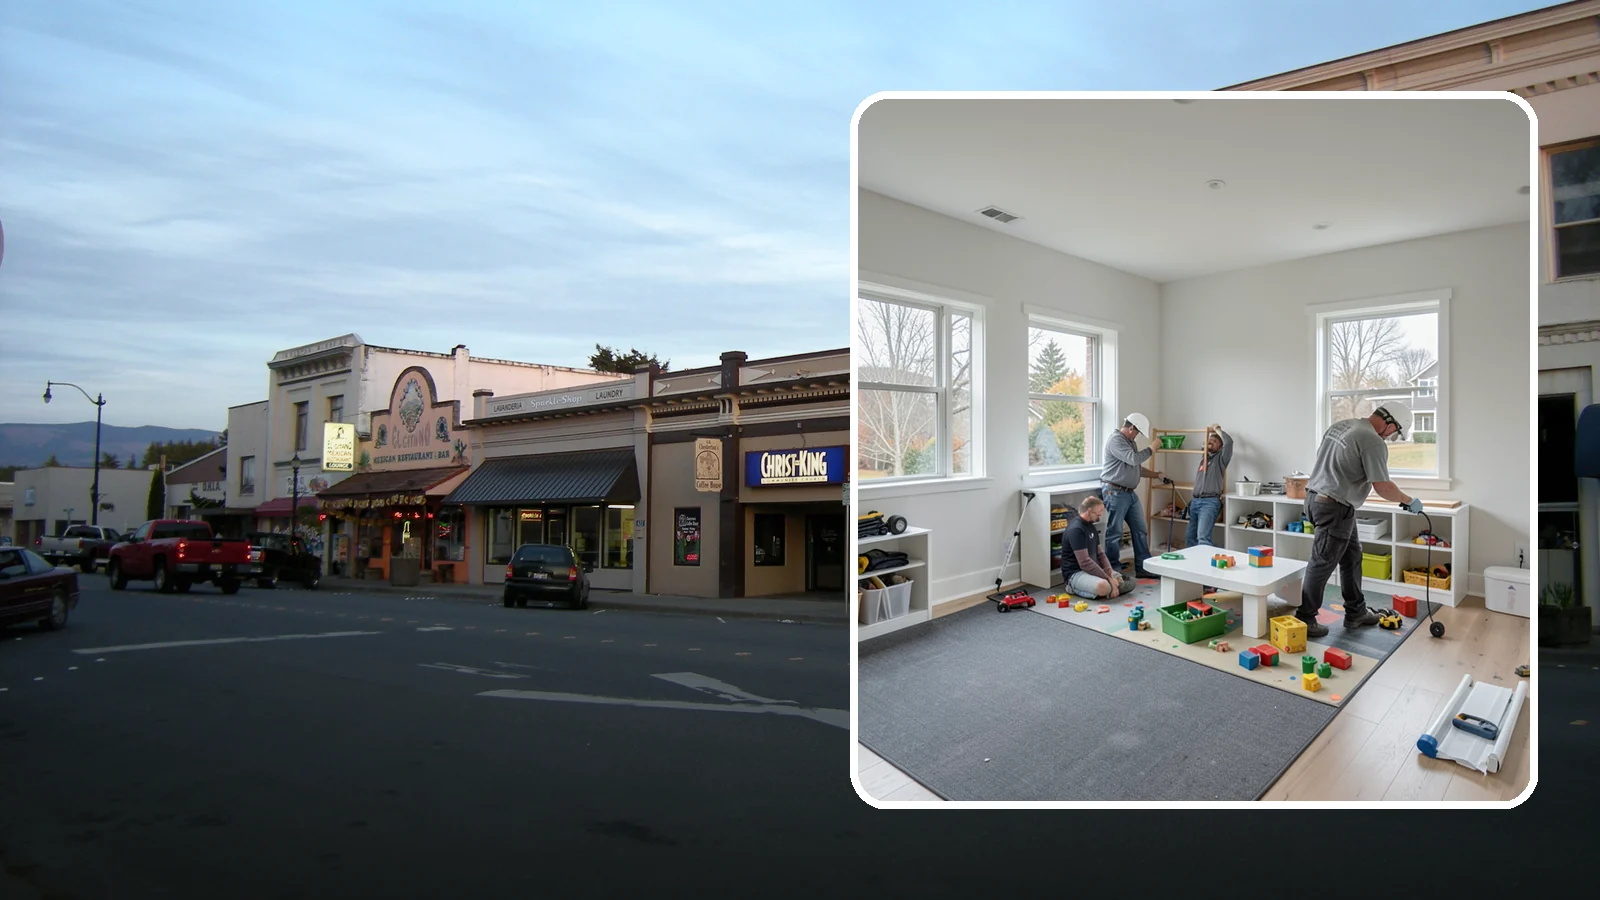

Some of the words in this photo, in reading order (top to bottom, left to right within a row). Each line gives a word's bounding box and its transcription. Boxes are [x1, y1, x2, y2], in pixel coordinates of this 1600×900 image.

[595, 389, 623, 400] LAUNDRY
[561, 395, 582, 406] Shop
[493, 402, 522, 413] LAVANDERIA
[373, 455, 396, 464] MEXICAN
[397, 451, 432, 462] RESTAURANT
[438, 450, 450, 459] BAR
[760, 452, 797, 478] CHRIST
[799, 450, 827, 476] KING
